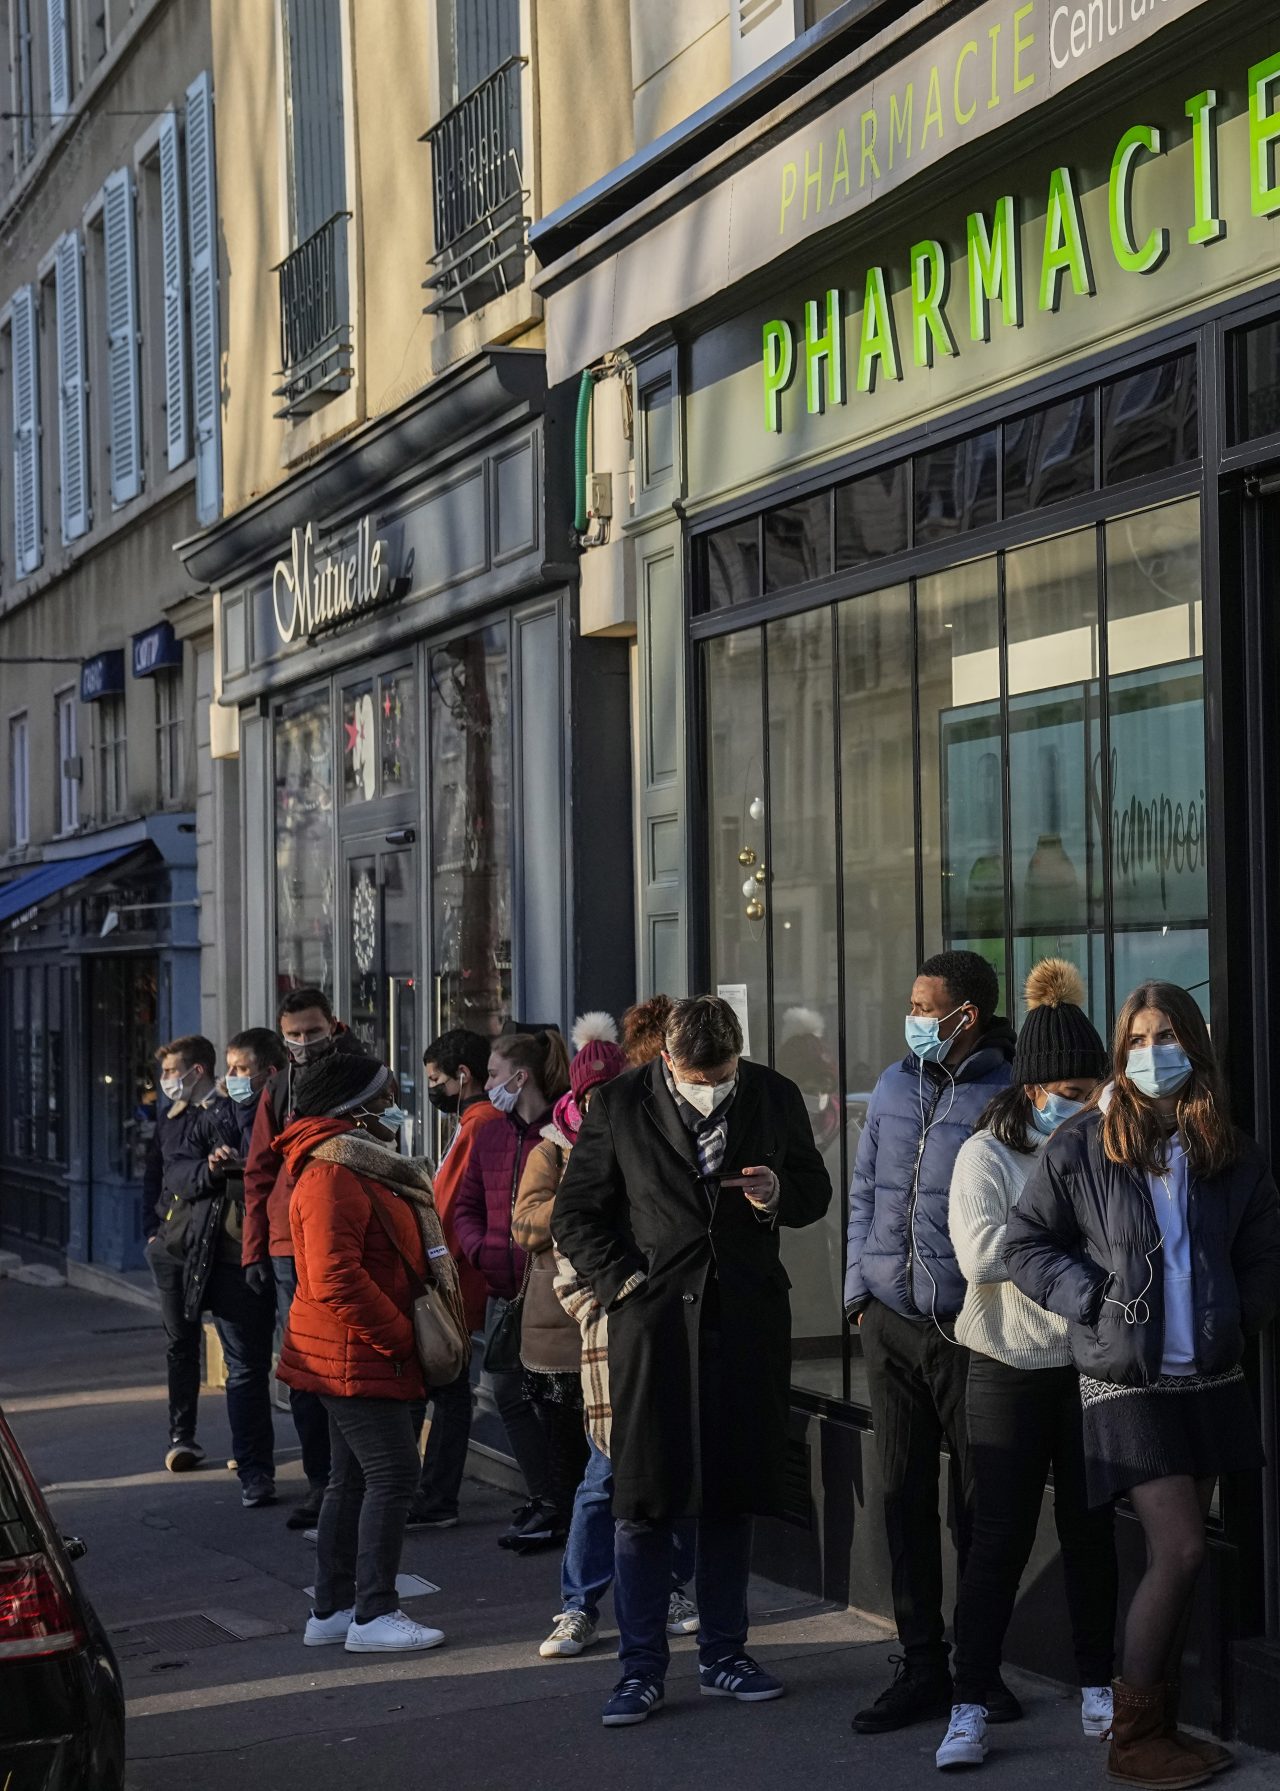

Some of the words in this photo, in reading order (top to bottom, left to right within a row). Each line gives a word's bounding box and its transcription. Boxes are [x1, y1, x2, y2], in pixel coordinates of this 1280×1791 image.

[780, 2, 1036, 235] PHARMACIE
[1050, 0, 1167, 69] Centr
[273, 515, 382, 643] Mutuelle
